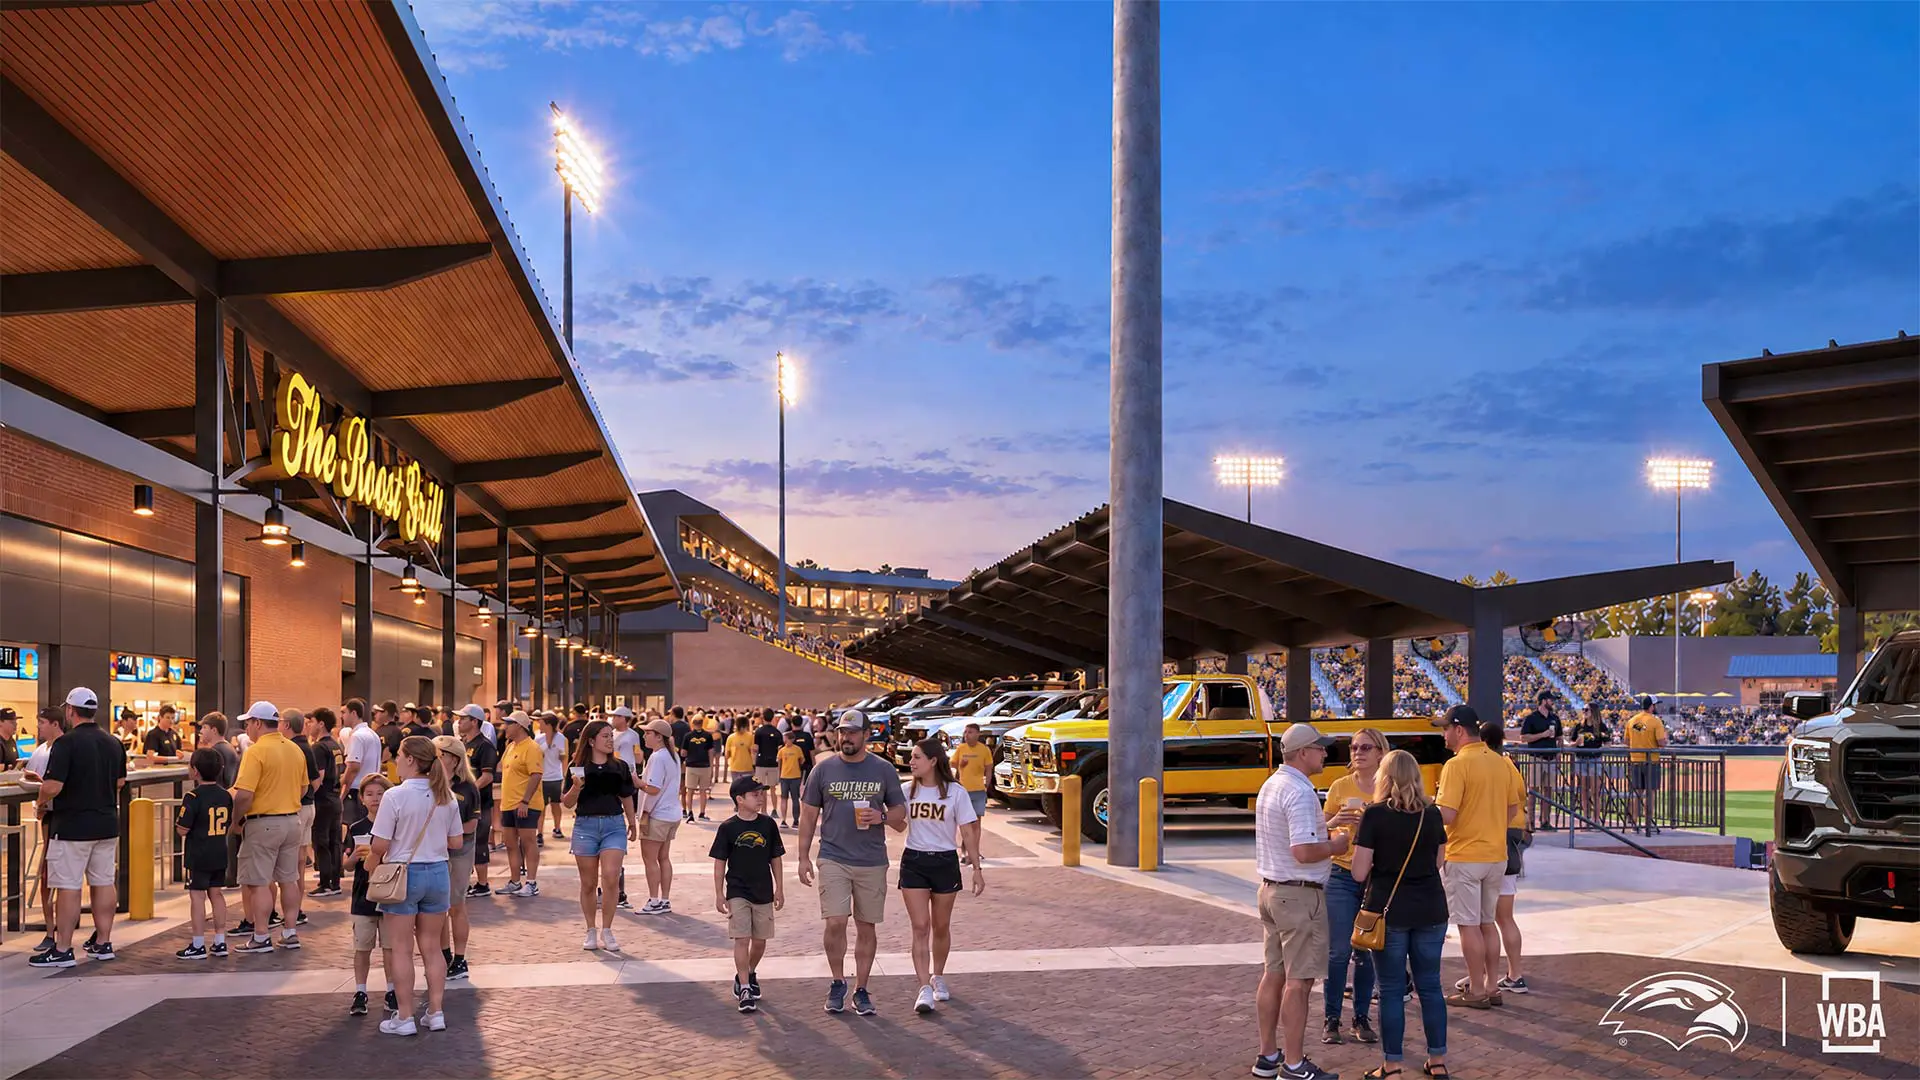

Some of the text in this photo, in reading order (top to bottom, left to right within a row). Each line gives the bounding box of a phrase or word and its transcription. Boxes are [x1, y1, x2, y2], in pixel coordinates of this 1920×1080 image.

[281, 372, 444, 543] The Roost Grill
[828, 781, 881, 792] SOUTHERN
[842, 791, 865, 800] MISS
[909, 802, 946, 821] USM
[207, 807, 228, 836] 12
